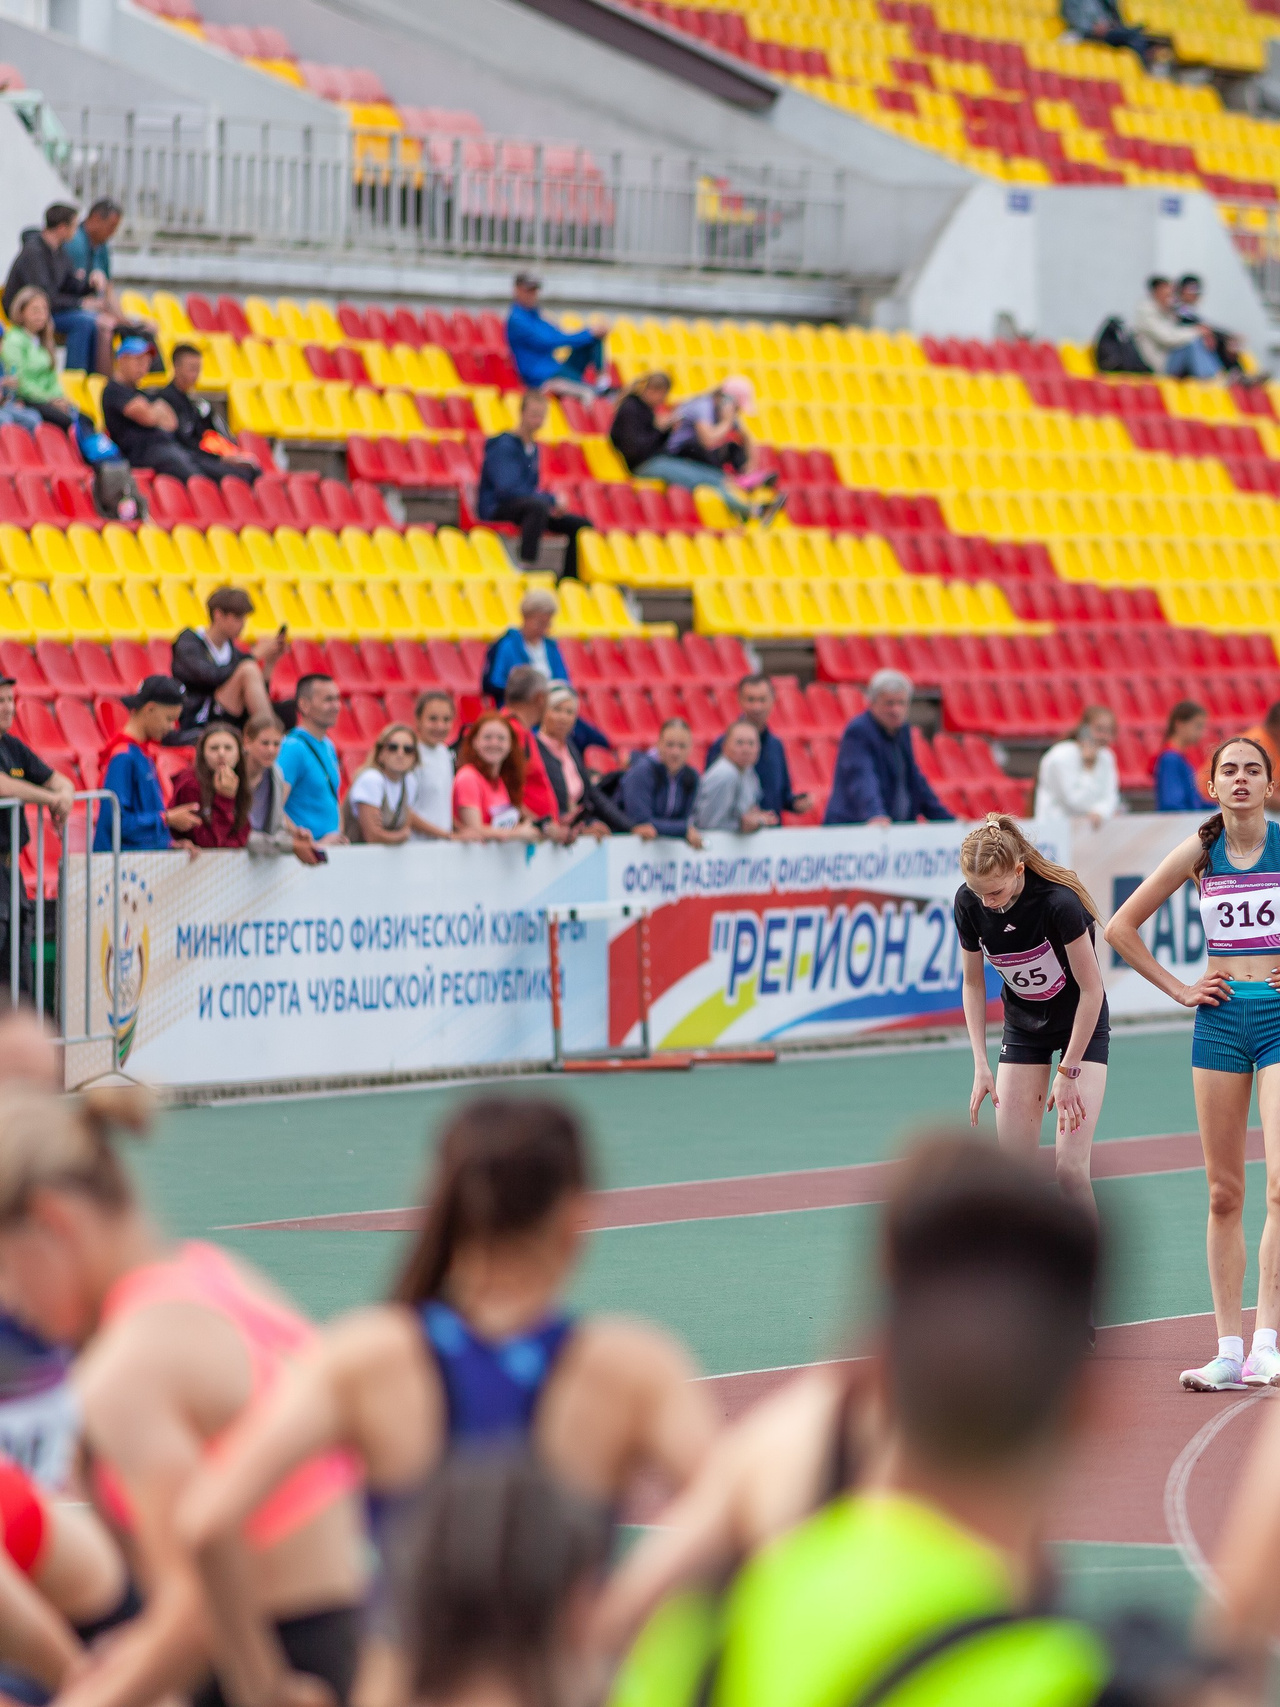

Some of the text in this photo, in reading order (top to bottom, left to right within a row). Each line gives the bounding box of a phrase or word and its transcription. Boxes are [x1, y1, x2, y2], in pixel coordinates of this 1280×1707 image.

[623, 859, 676, 894] ФОНД
[681, 856, 771, 890] РАЗВИТИЯ
[776, 842, 888, 884] ФИЗИЧЕСКОЙ
[175, 903, 588, 959] МИНИСТЕРСТВО ФИЗИЧЕСКОЙ КУЛЬТРЫ
[1217, 900, 1275, 928] 316
[199, 984, 213, 1020] И
[219, 979, 302, 1018] СПОРТА
[308, 963, 434, 1013] ЧУВАШСКОЙ
